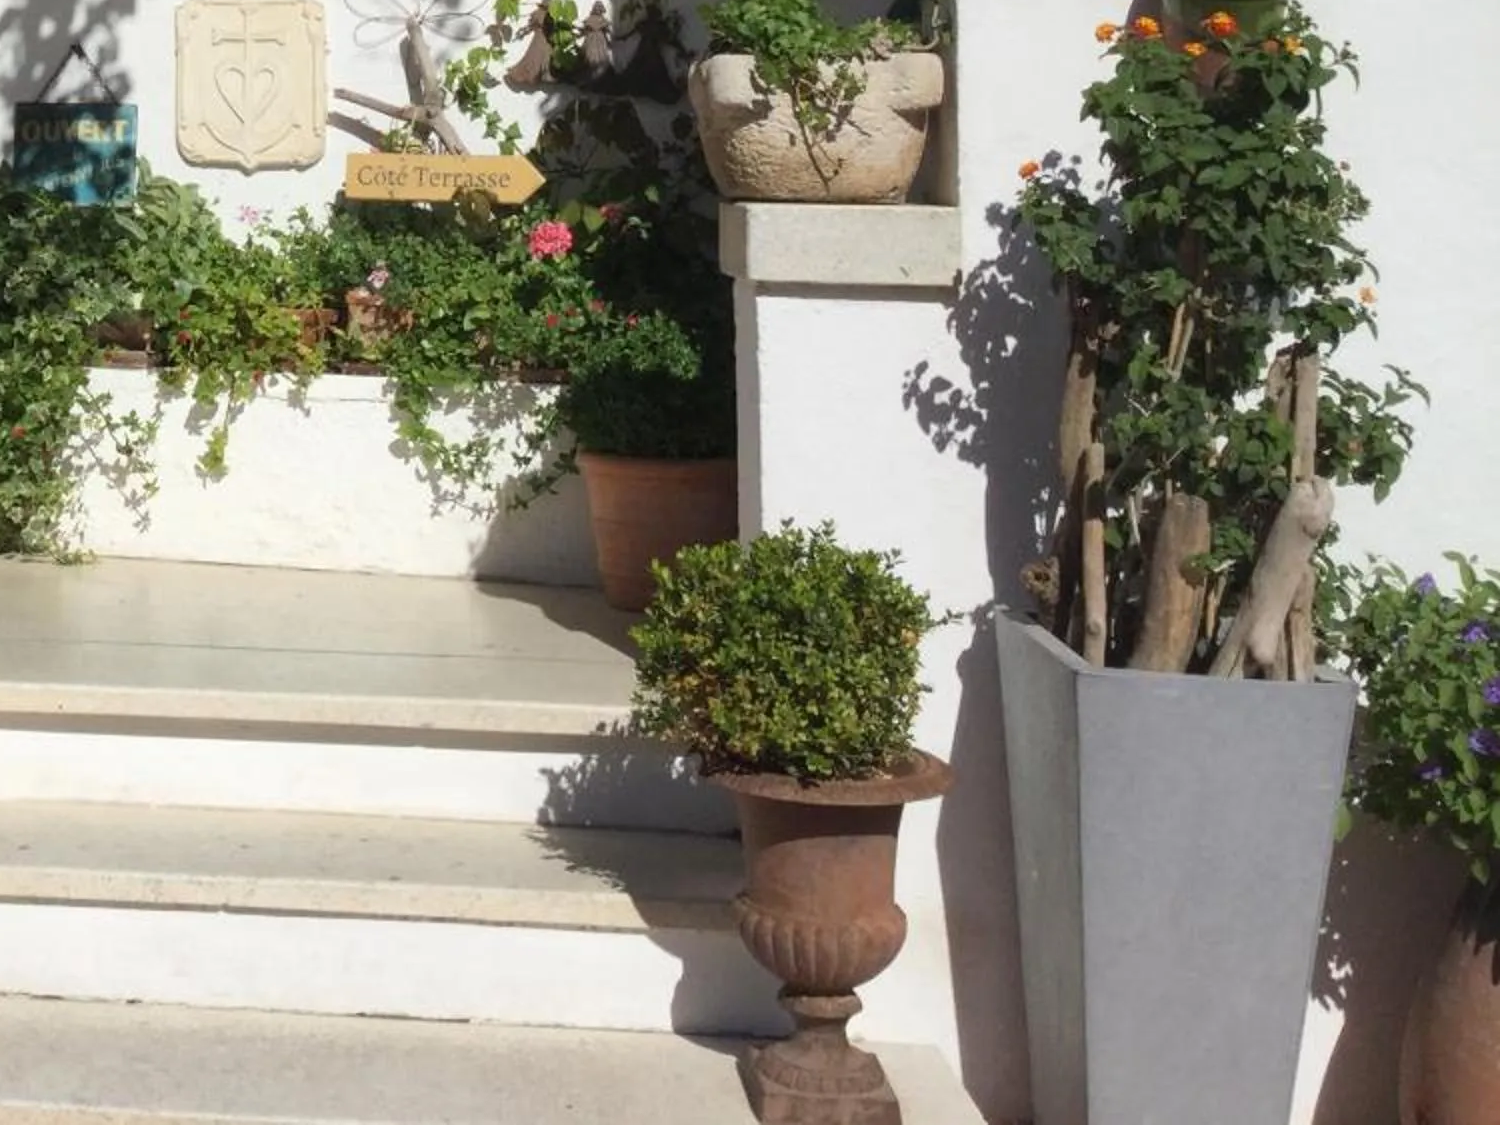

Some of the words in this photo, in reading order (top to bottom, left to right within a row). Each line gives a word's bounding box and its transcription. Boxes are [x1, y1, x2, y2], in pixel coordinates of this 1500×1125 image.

[22, 118, 129, 142] OUVERT
[357, 164, 405, 187] Côté
[413, 165, 511, 188] Terrasse
